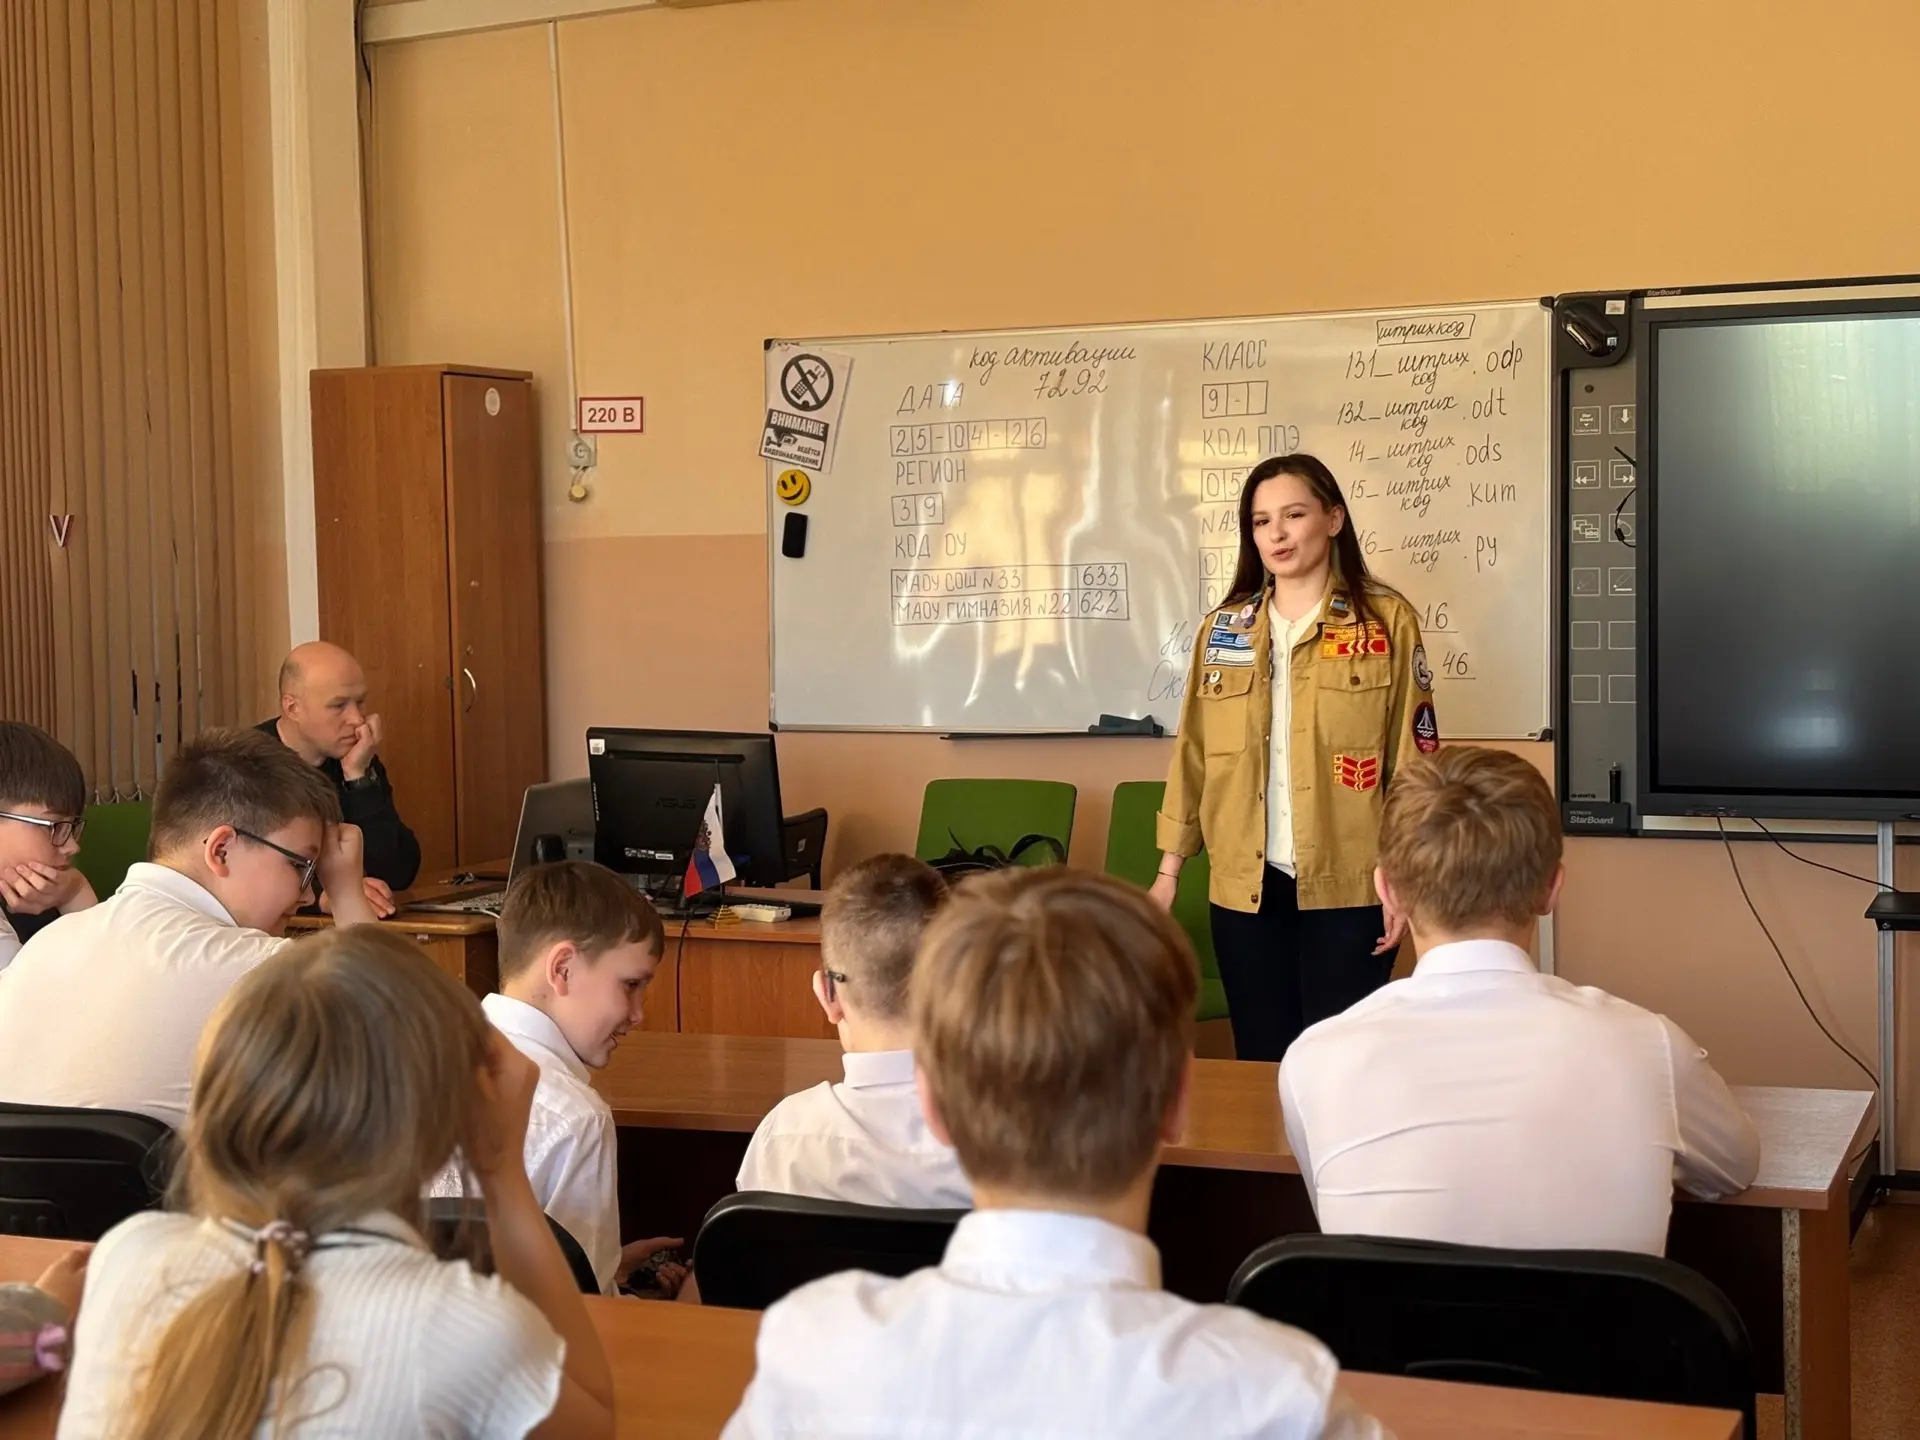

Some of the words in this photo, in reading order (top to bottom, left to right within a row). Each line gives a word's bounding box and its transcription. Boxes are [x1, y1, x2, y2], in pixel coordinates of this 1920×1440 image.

[1646, 288, 1682, 297] StarBoard
[970, 346, 999, 386] код
[1004, 340, 1137, 368] активации
[1202, 338, 1267, 371] КЛАСС
[1397, 351, 1470, 375] штрих
[1034, 367, 1109, 399] 7292
[1411, 371, 1438, 395] код
[896, 382, 965, 416] ДАТА
[1384, 394, 1459, 418] штрих
[587, 407, 617, 423] 220
[623, 406, 635, 423] В
[769, 411, 826, 438] ВНИМАНИЕ
[1400, 413, 1429, 438] код
[1202, 426, 1248, 456] КОД
[1257, 424, 1301, 454] ППЭ
[1386, 435, 1455, 460] штрих
[896, 458, 967, 486] РЕГИОН
[1407, 453, 1433, 477] код
[1386, 474, 1451, 499] штрих
[1400, 493, 1432, 518] код
[895, 533, 931, 559] КОД
[944, 532, 968, 557] ОУ
[1401, 529, 1461, 551] штрих
[1410, 549, 1440, 573] код
[895, 572, 940, 594] МАОУ
[945, 572, 977, 592] СОШ
[1083, 565, 1119, 588] 633
[897, 601, 941, 621] МАОУ
[946, 596, 1032, 621] ГИМНАЗИЯ
[1080, 590, 1119, 614] 622
[1442, 650, 1469, 676] 46
[1570, 815, 1614, 825] StarBoard
